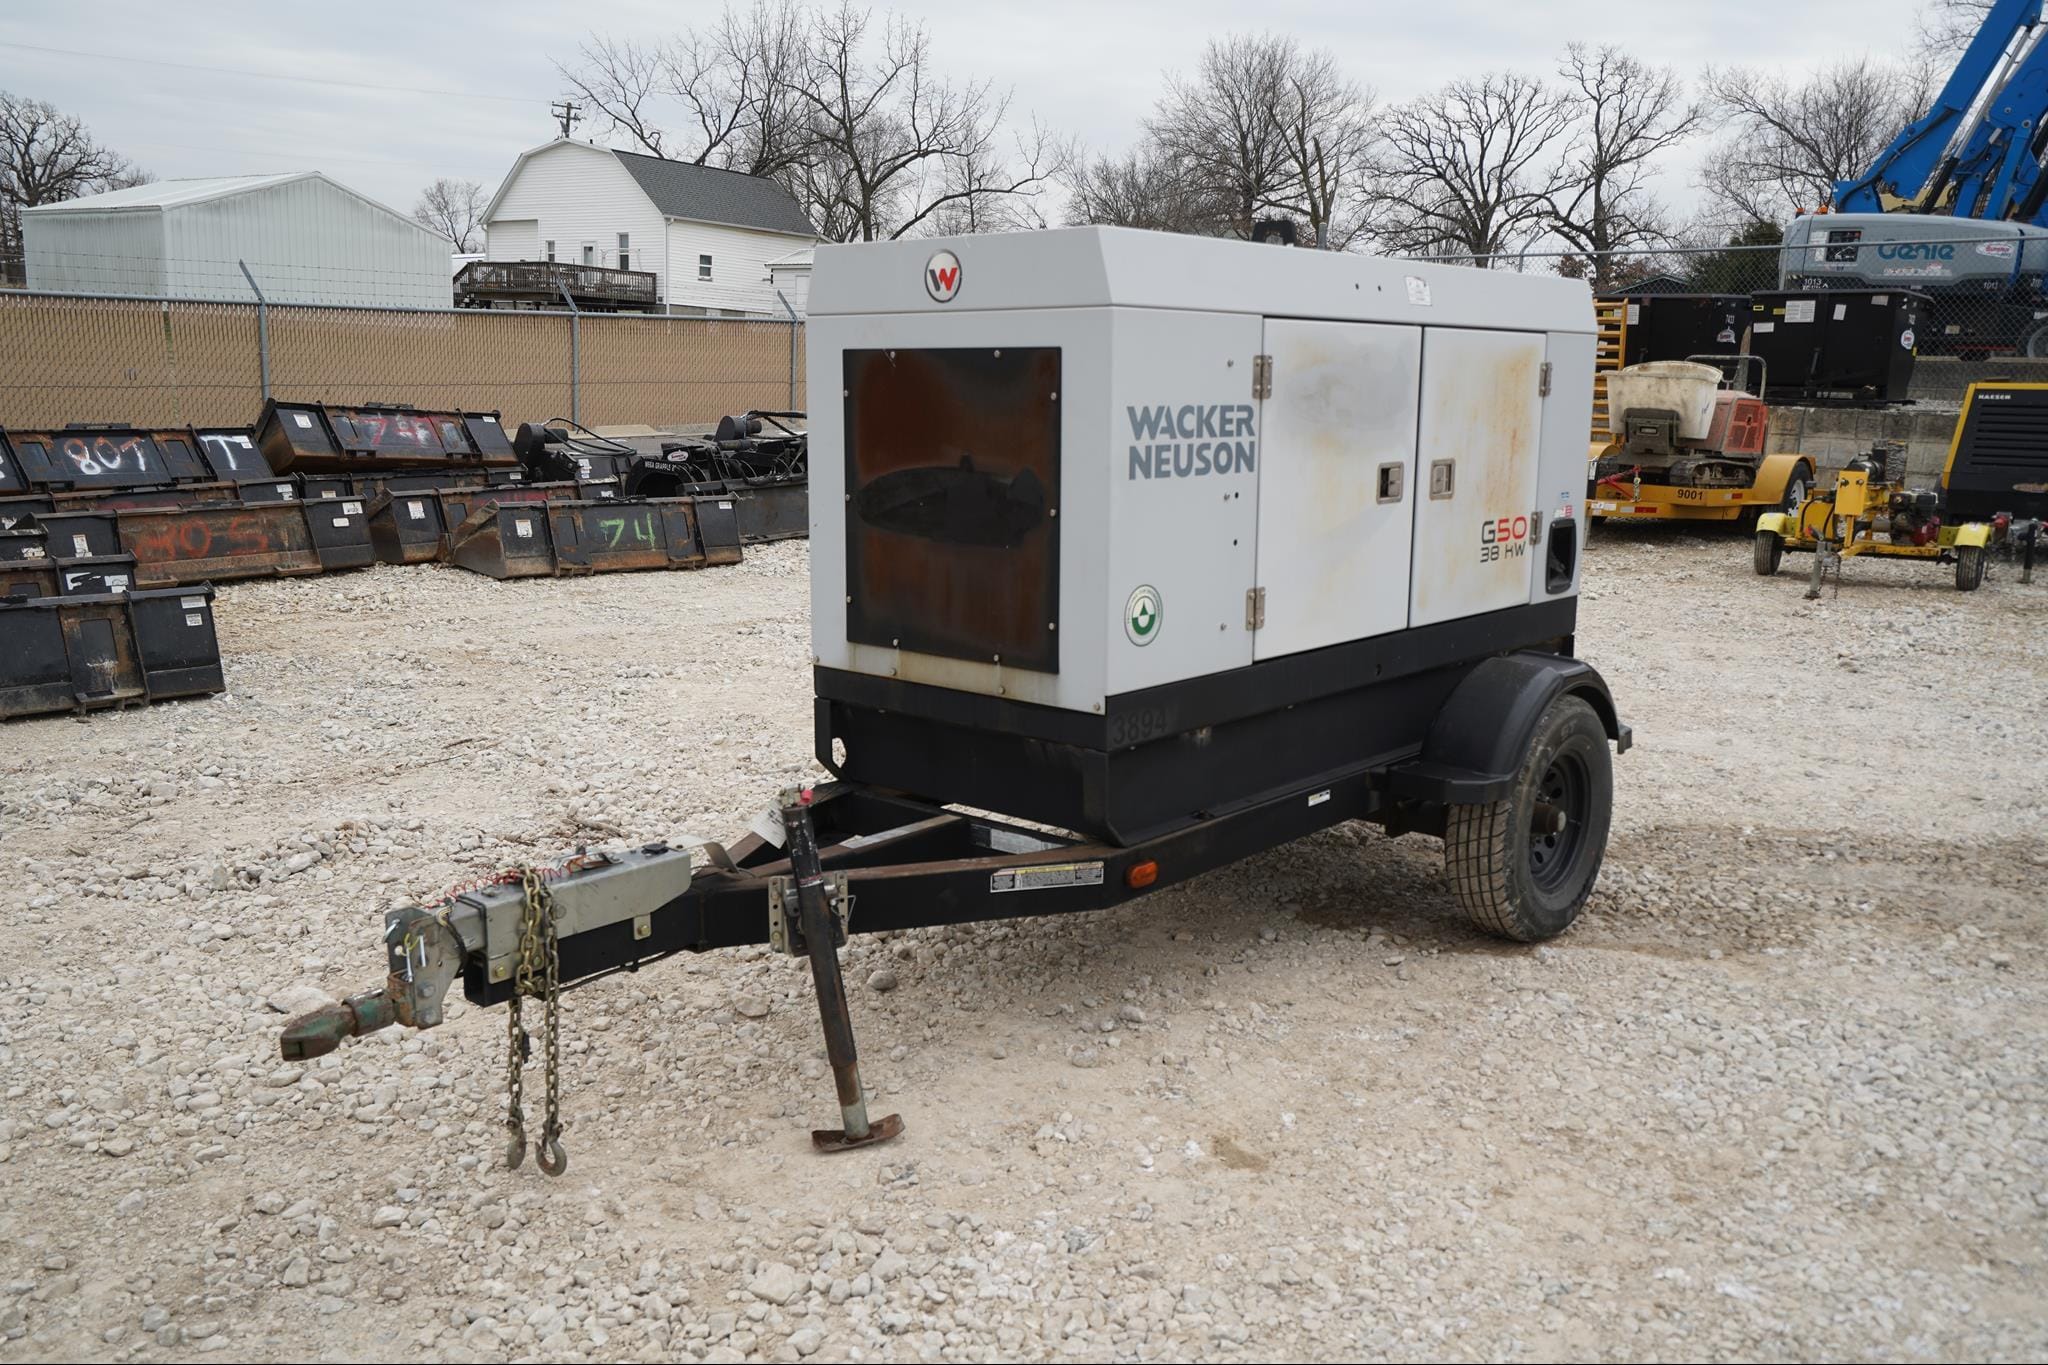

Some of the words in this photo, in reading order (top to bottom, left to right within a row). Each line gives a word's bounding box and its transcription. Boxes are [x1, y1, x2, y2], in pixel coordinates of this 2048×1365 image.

[1877, 238, 1954, 260] Genie
[929, 267, 958, 292] W
[1127, 405, 1255, 441] WACKER
[1129, 441, 1255, 480] NEUSON
[1677, 489, 1703, 500] 9001
[600, 513, 656, 551] 74
[1482, 516, 1527, 544] G50
[1480, 545, 1499, 563] 38
[1112, 706, 1168, 745] 3894
